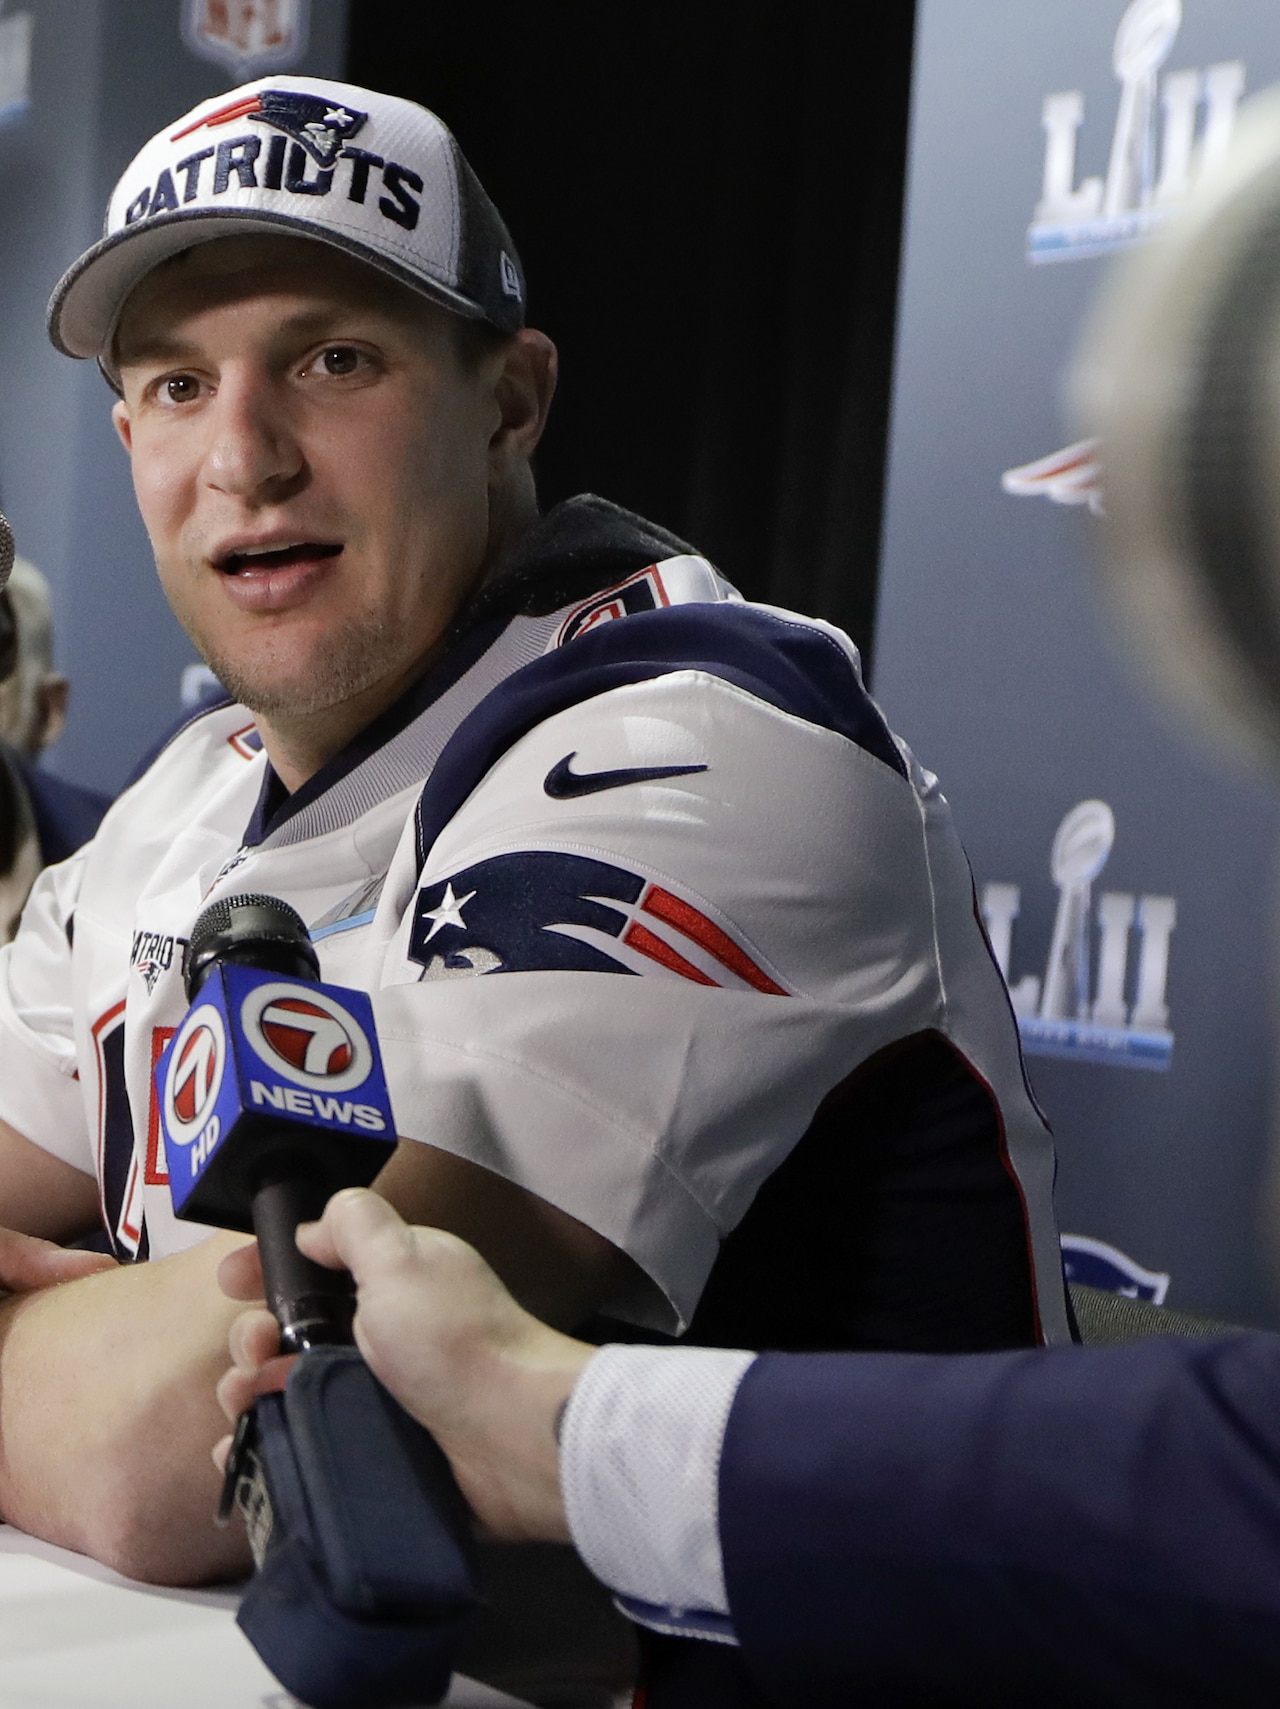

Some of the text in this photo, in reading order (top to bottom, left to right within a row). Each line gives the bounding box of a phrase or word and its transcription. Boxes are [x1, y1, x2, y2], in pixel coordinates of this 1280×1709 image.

[125, 134, 424, 231] PATRIOTS
[130, 930, 190, 976] ATRIOT
[260, 998, 354, 1076] 7
[250, 1080, 387, 1132] NEWS
[191, 1115, 221, 1178] HD
